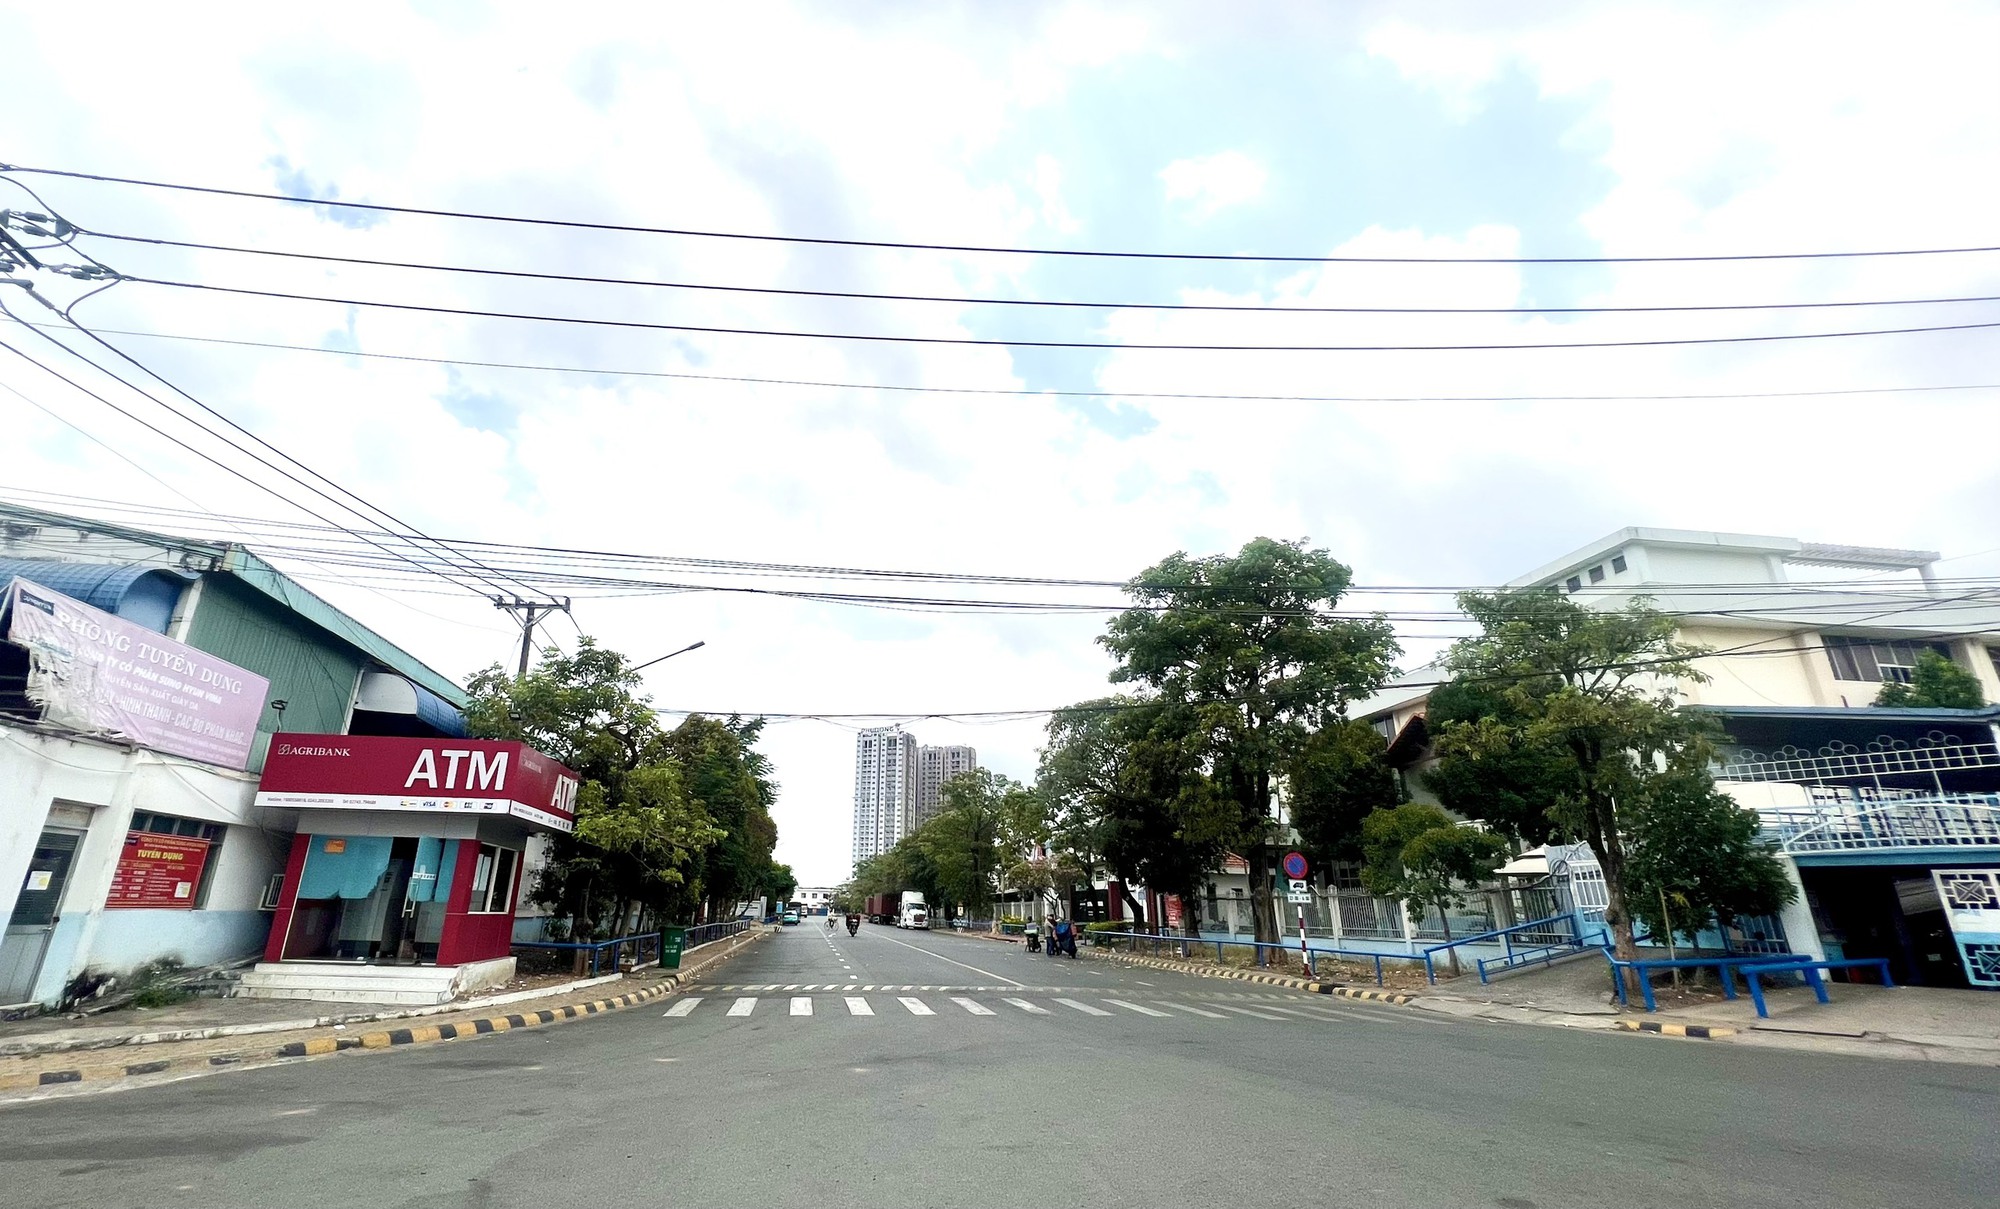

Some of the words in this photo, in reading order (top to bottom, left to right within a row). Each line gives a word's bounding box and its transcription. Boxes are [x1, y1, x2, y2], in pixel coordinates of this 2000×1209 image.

[137, 642, 198, 677] TUYỂN
[200, 667, 242, 694] DỤNG
[290, 746, 350, 757] AGRIBANK
[404, 749, 509, 791] ATM
